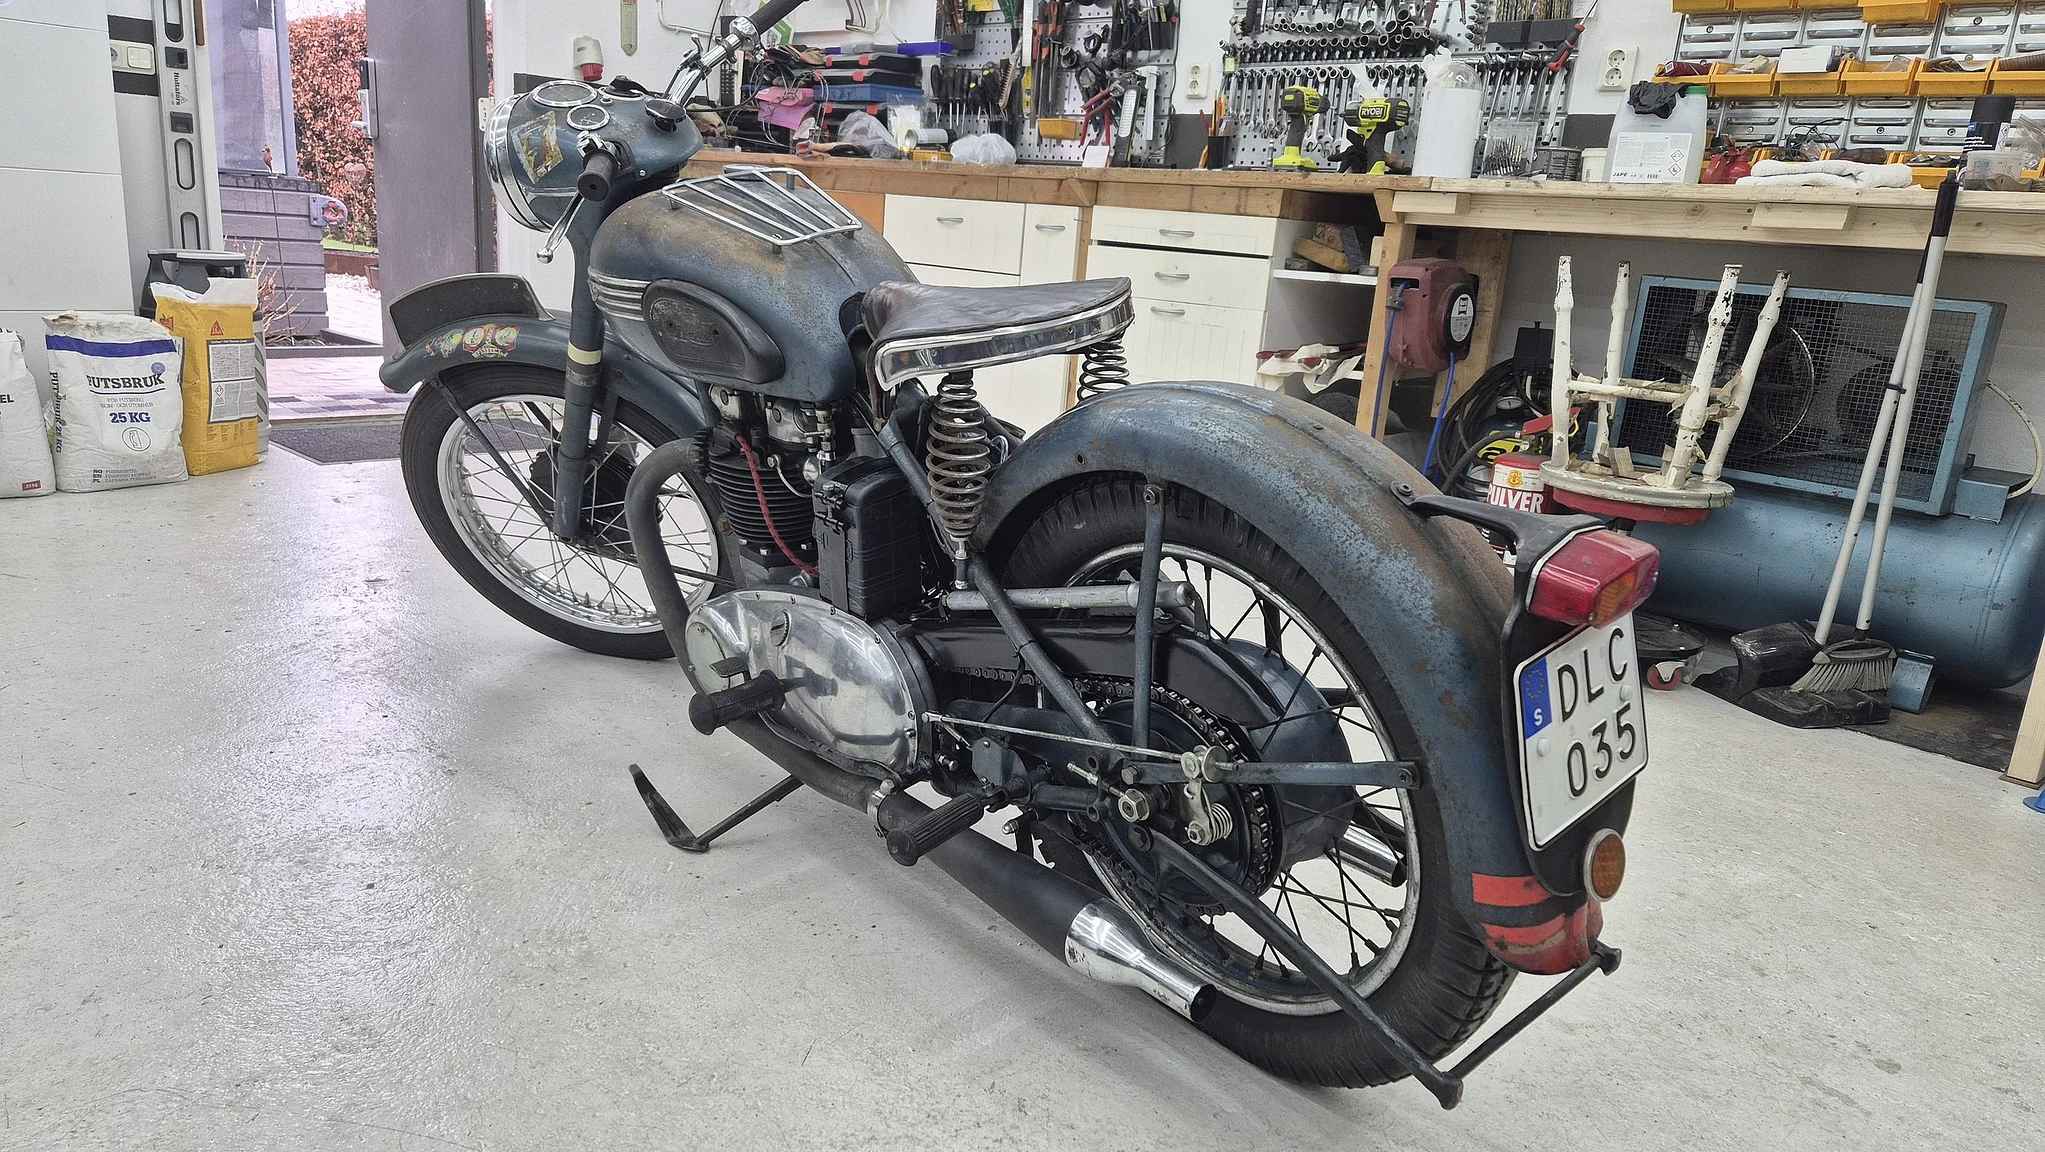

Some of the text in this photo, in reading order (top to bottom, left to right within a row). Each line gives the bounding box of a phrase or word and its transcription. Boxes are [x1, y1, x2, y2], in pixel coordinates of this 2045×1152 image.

[1361, 107, 1383, 116] RYOBI
[86, 373, 165, 389] PUTSBRUK
[109, 412, 151, 423] 25 KG
[1487, 483, 1544, 514] PULVER
[1557, 627, 1628, 723] DLC
[1533, 708, 1543, 726] S
[1567, 702, 1636, 798] 035
